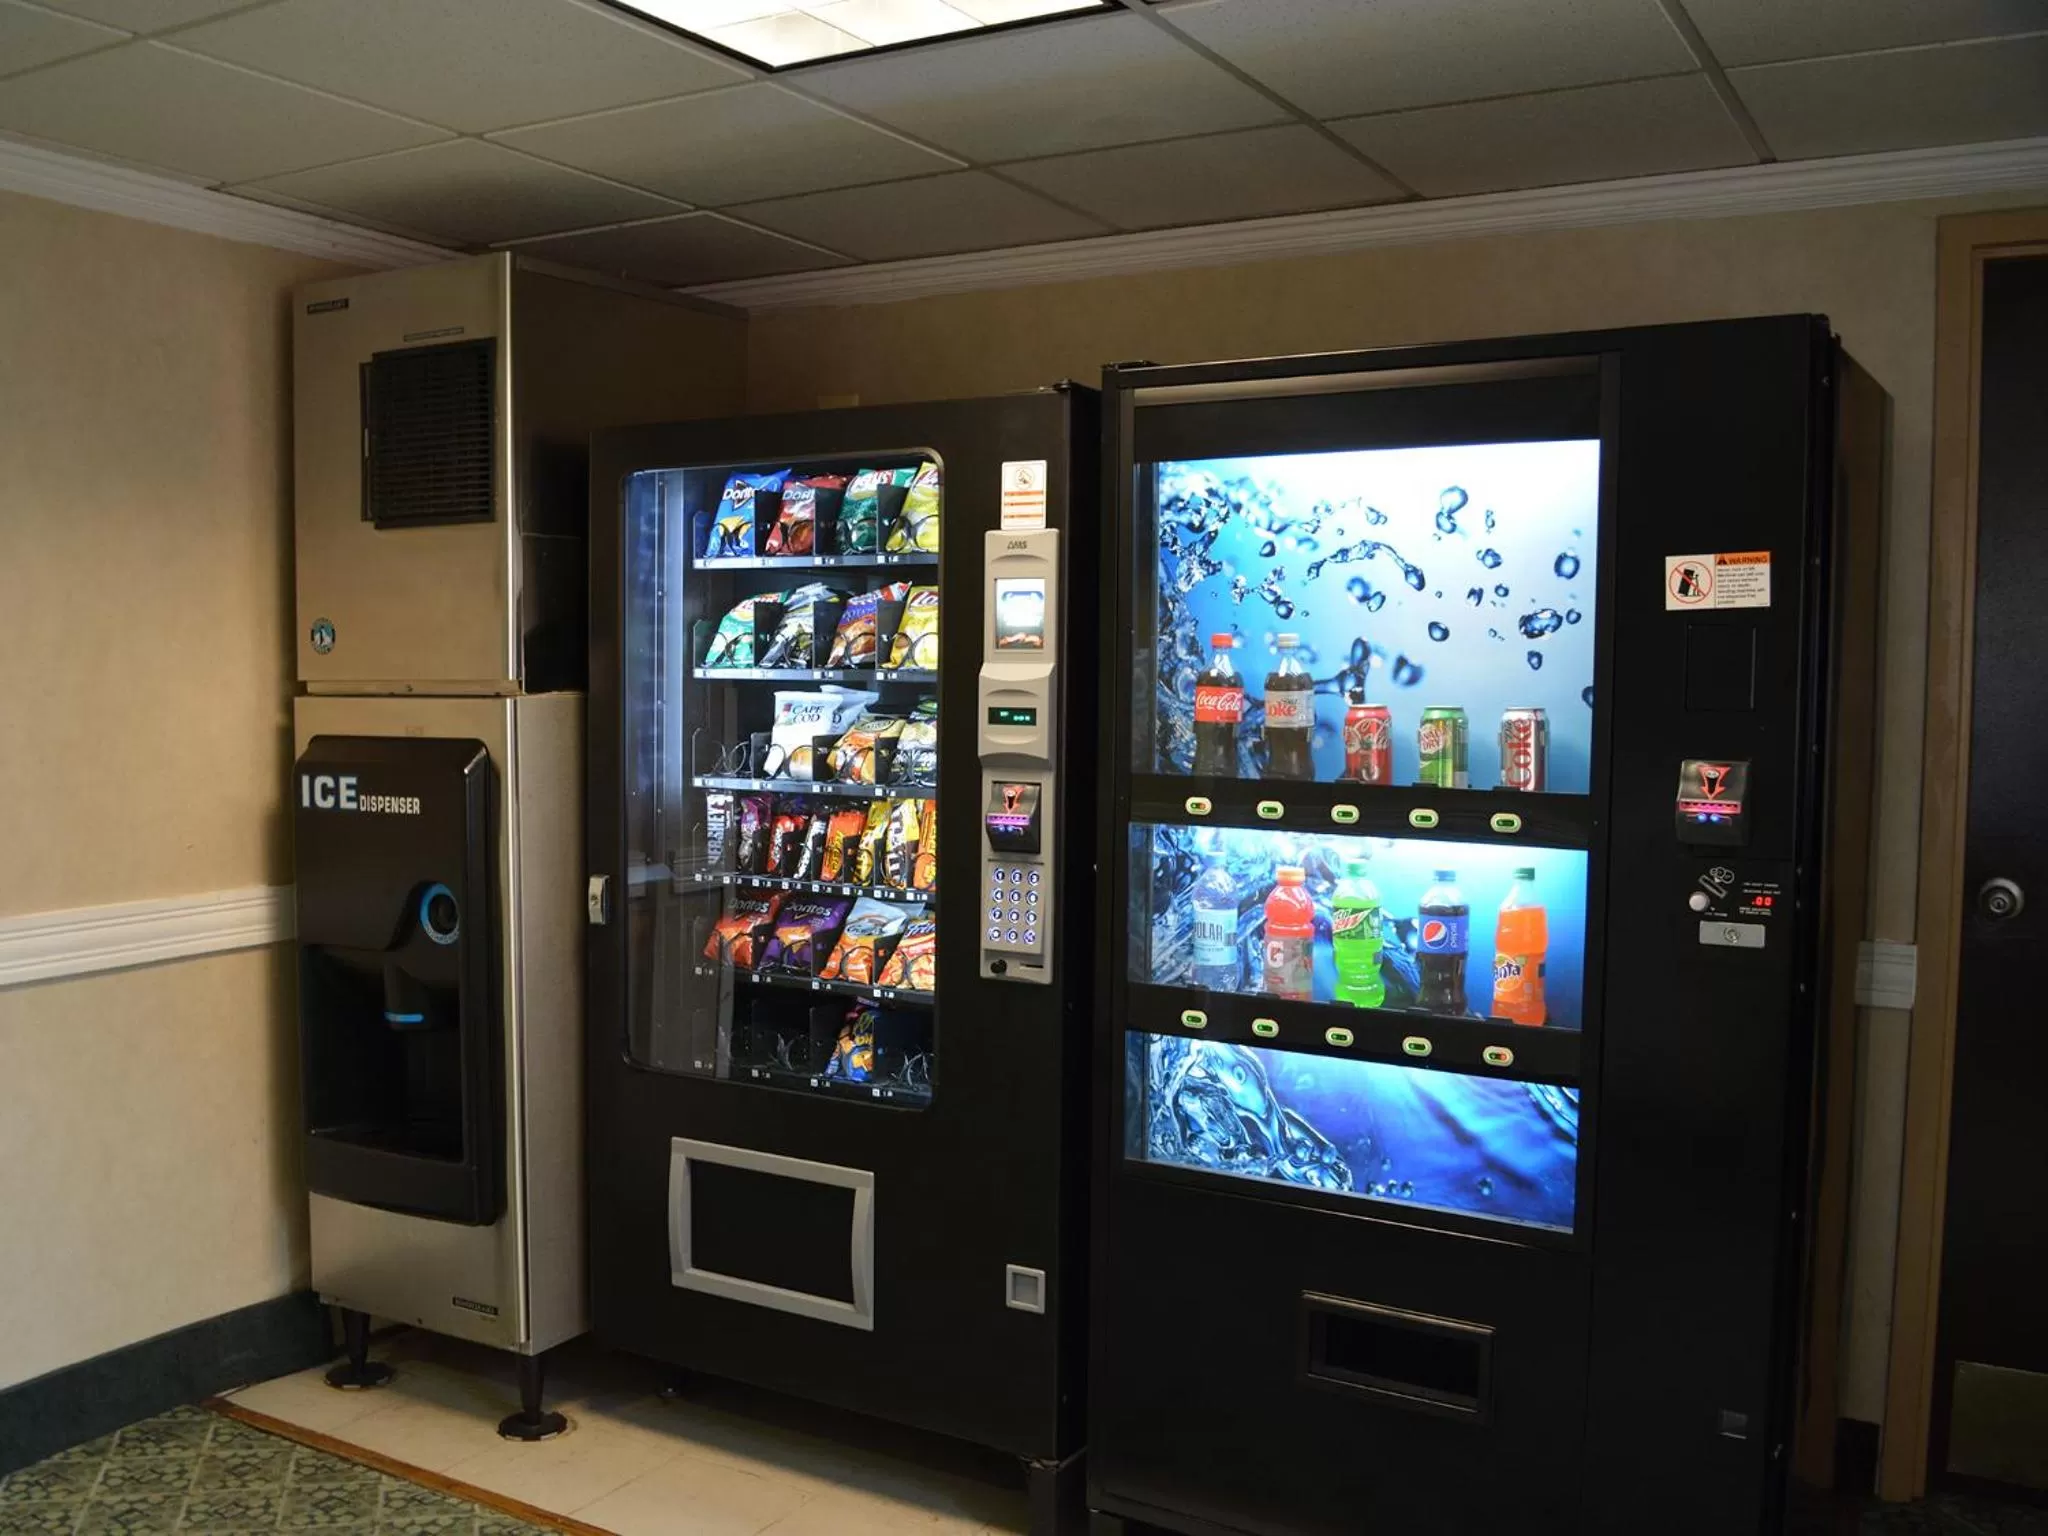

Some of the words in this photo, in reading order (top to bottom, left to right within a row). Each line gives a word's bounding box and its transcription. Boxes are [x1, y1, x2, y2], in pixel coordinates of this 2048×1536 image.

[301, 774, 358, 810] ICE
[359, 794, 421, 815] DISPENSER
[1266, 941, 1284, 968] G
